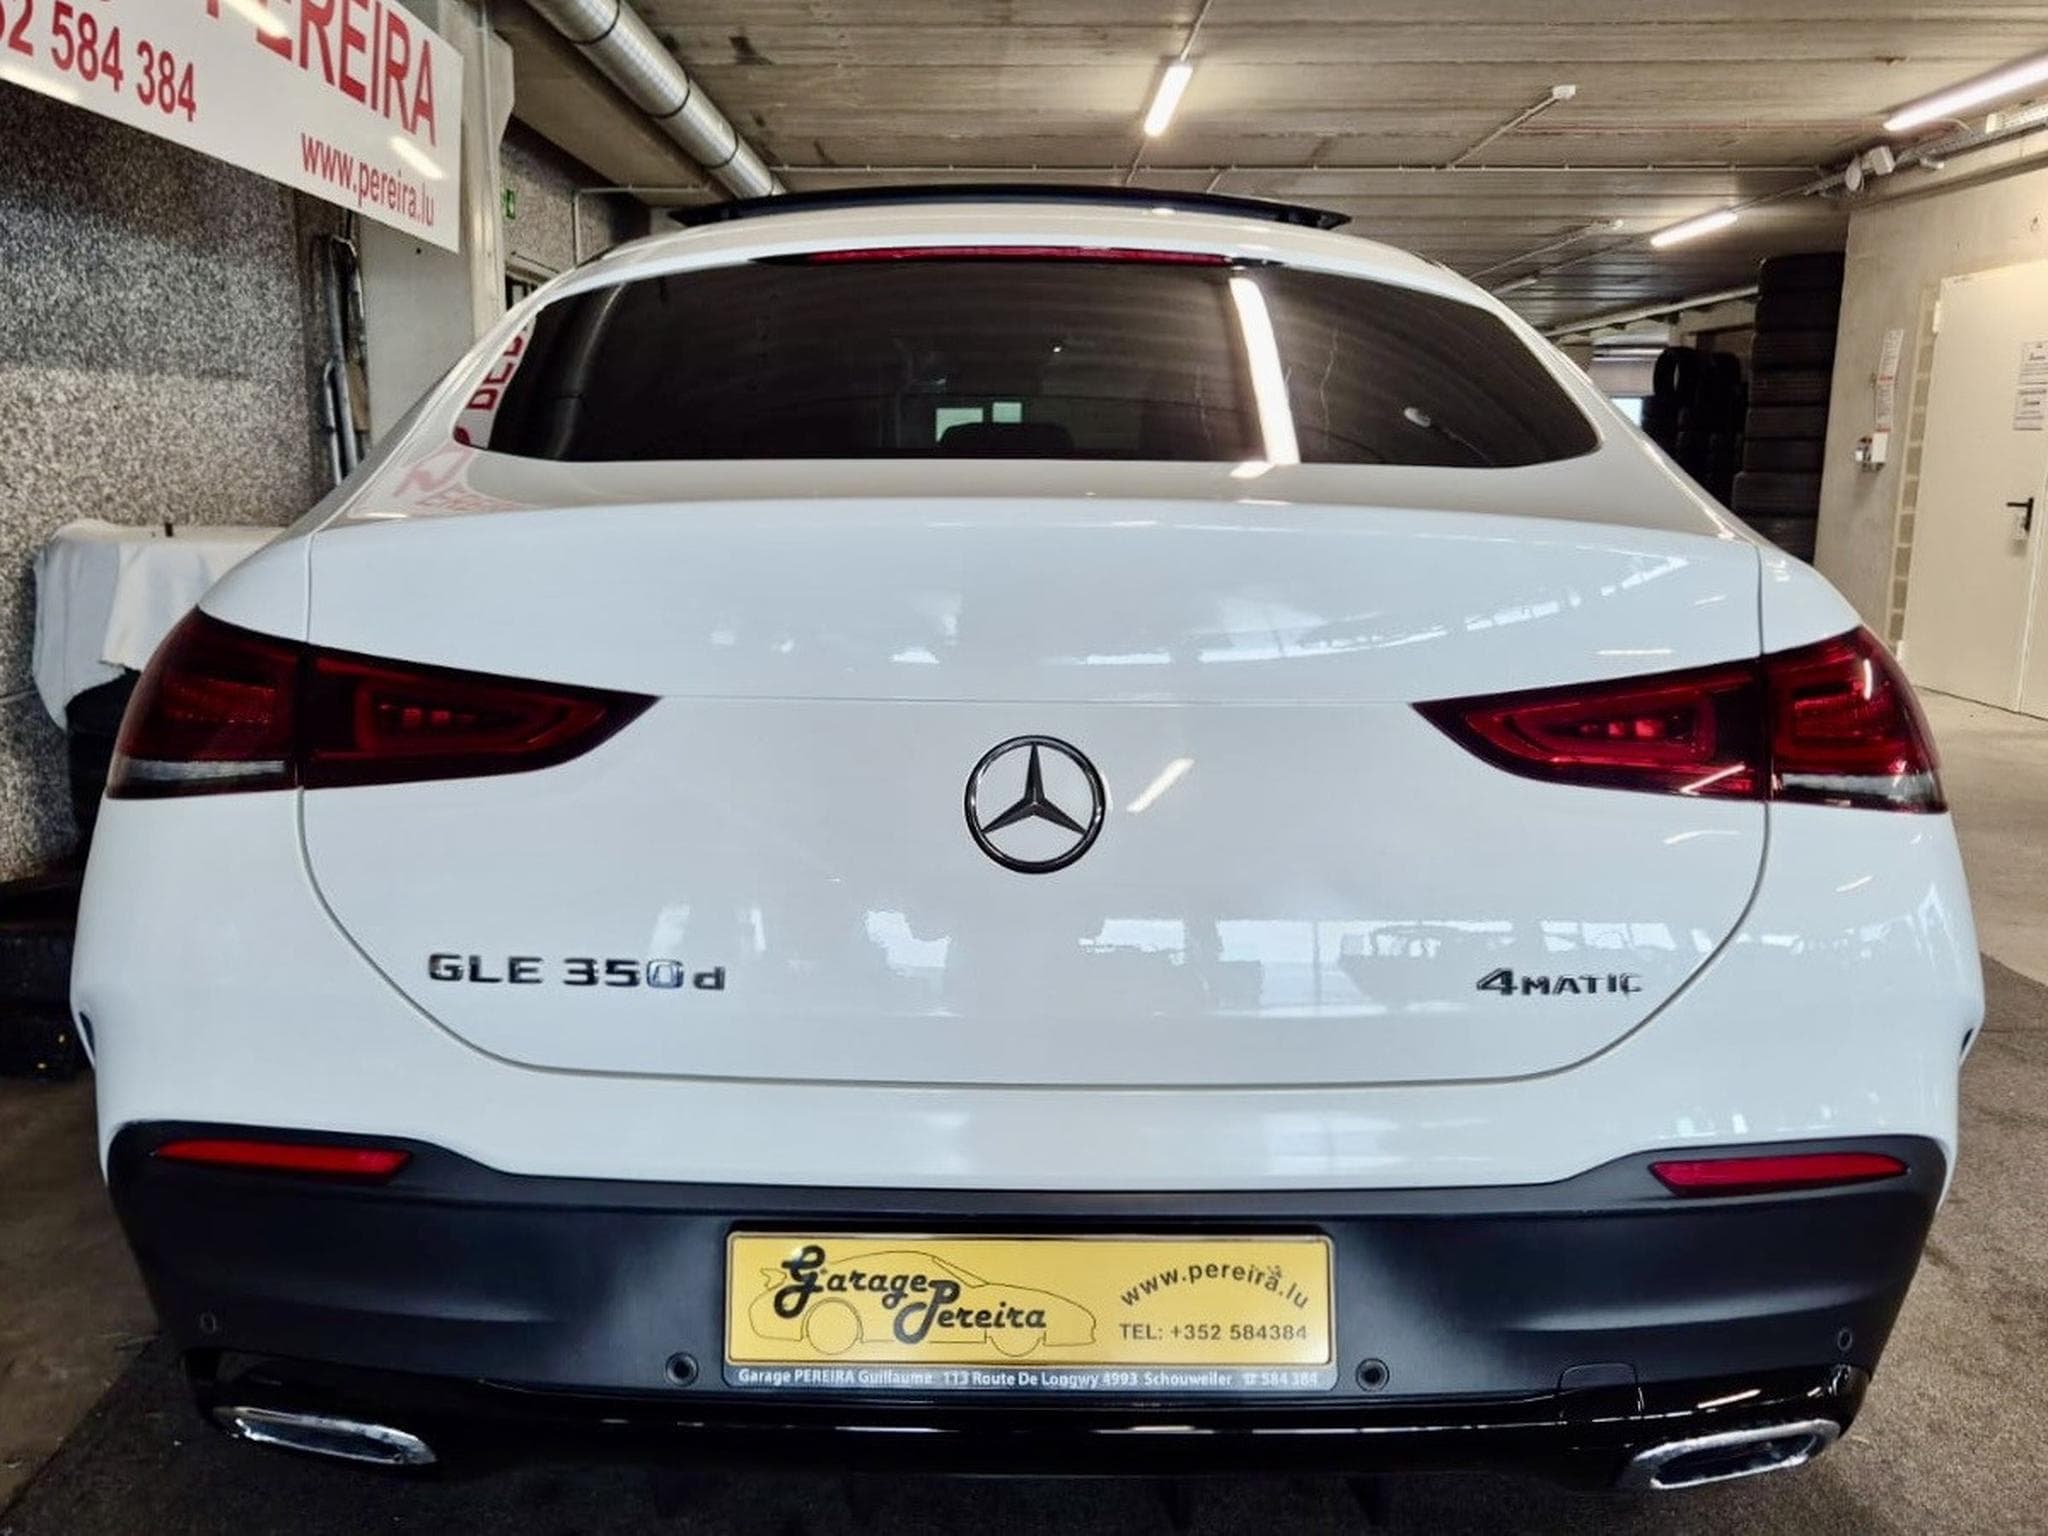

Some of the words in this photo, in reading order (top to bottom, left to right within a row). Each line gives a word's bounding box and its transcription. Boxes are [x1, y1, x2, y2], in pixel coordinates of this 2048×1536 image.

[51, 1, 124, 92] 584
[136, 40, 197, 122] 384
[301, 132, 435, 227] www.pereira.lu
[428, 953, 543, 984] GLE
[1476, 967, 1642, 997] 4MATIC
[774, 1245, 928, 1319] Garage
[1120, 1262, 1308, 1310] www.pereira.lu
[893, 1278, 1047, 1345] Pereira
[1119, 1323, 1163, 1341] TEL:
[1171, 1323, 1221, 1342] +352
[1229, 1324, 1308, 1342] 584384
[738, 1368, 792, 1386] Garage
[794, 1369, 854, 1384] PEREIRA
[858, 1369, 933, 1385] Guillaume
[973, 1370, 1015, 1386] Route
[1018, 1372, 1038, 1386] De
[1041, 1372, 1099, 1390] Longwy
[1144, 1372, 1232, 1386] Schouweiler
[1261, 1372, 1287, 1386] 584
